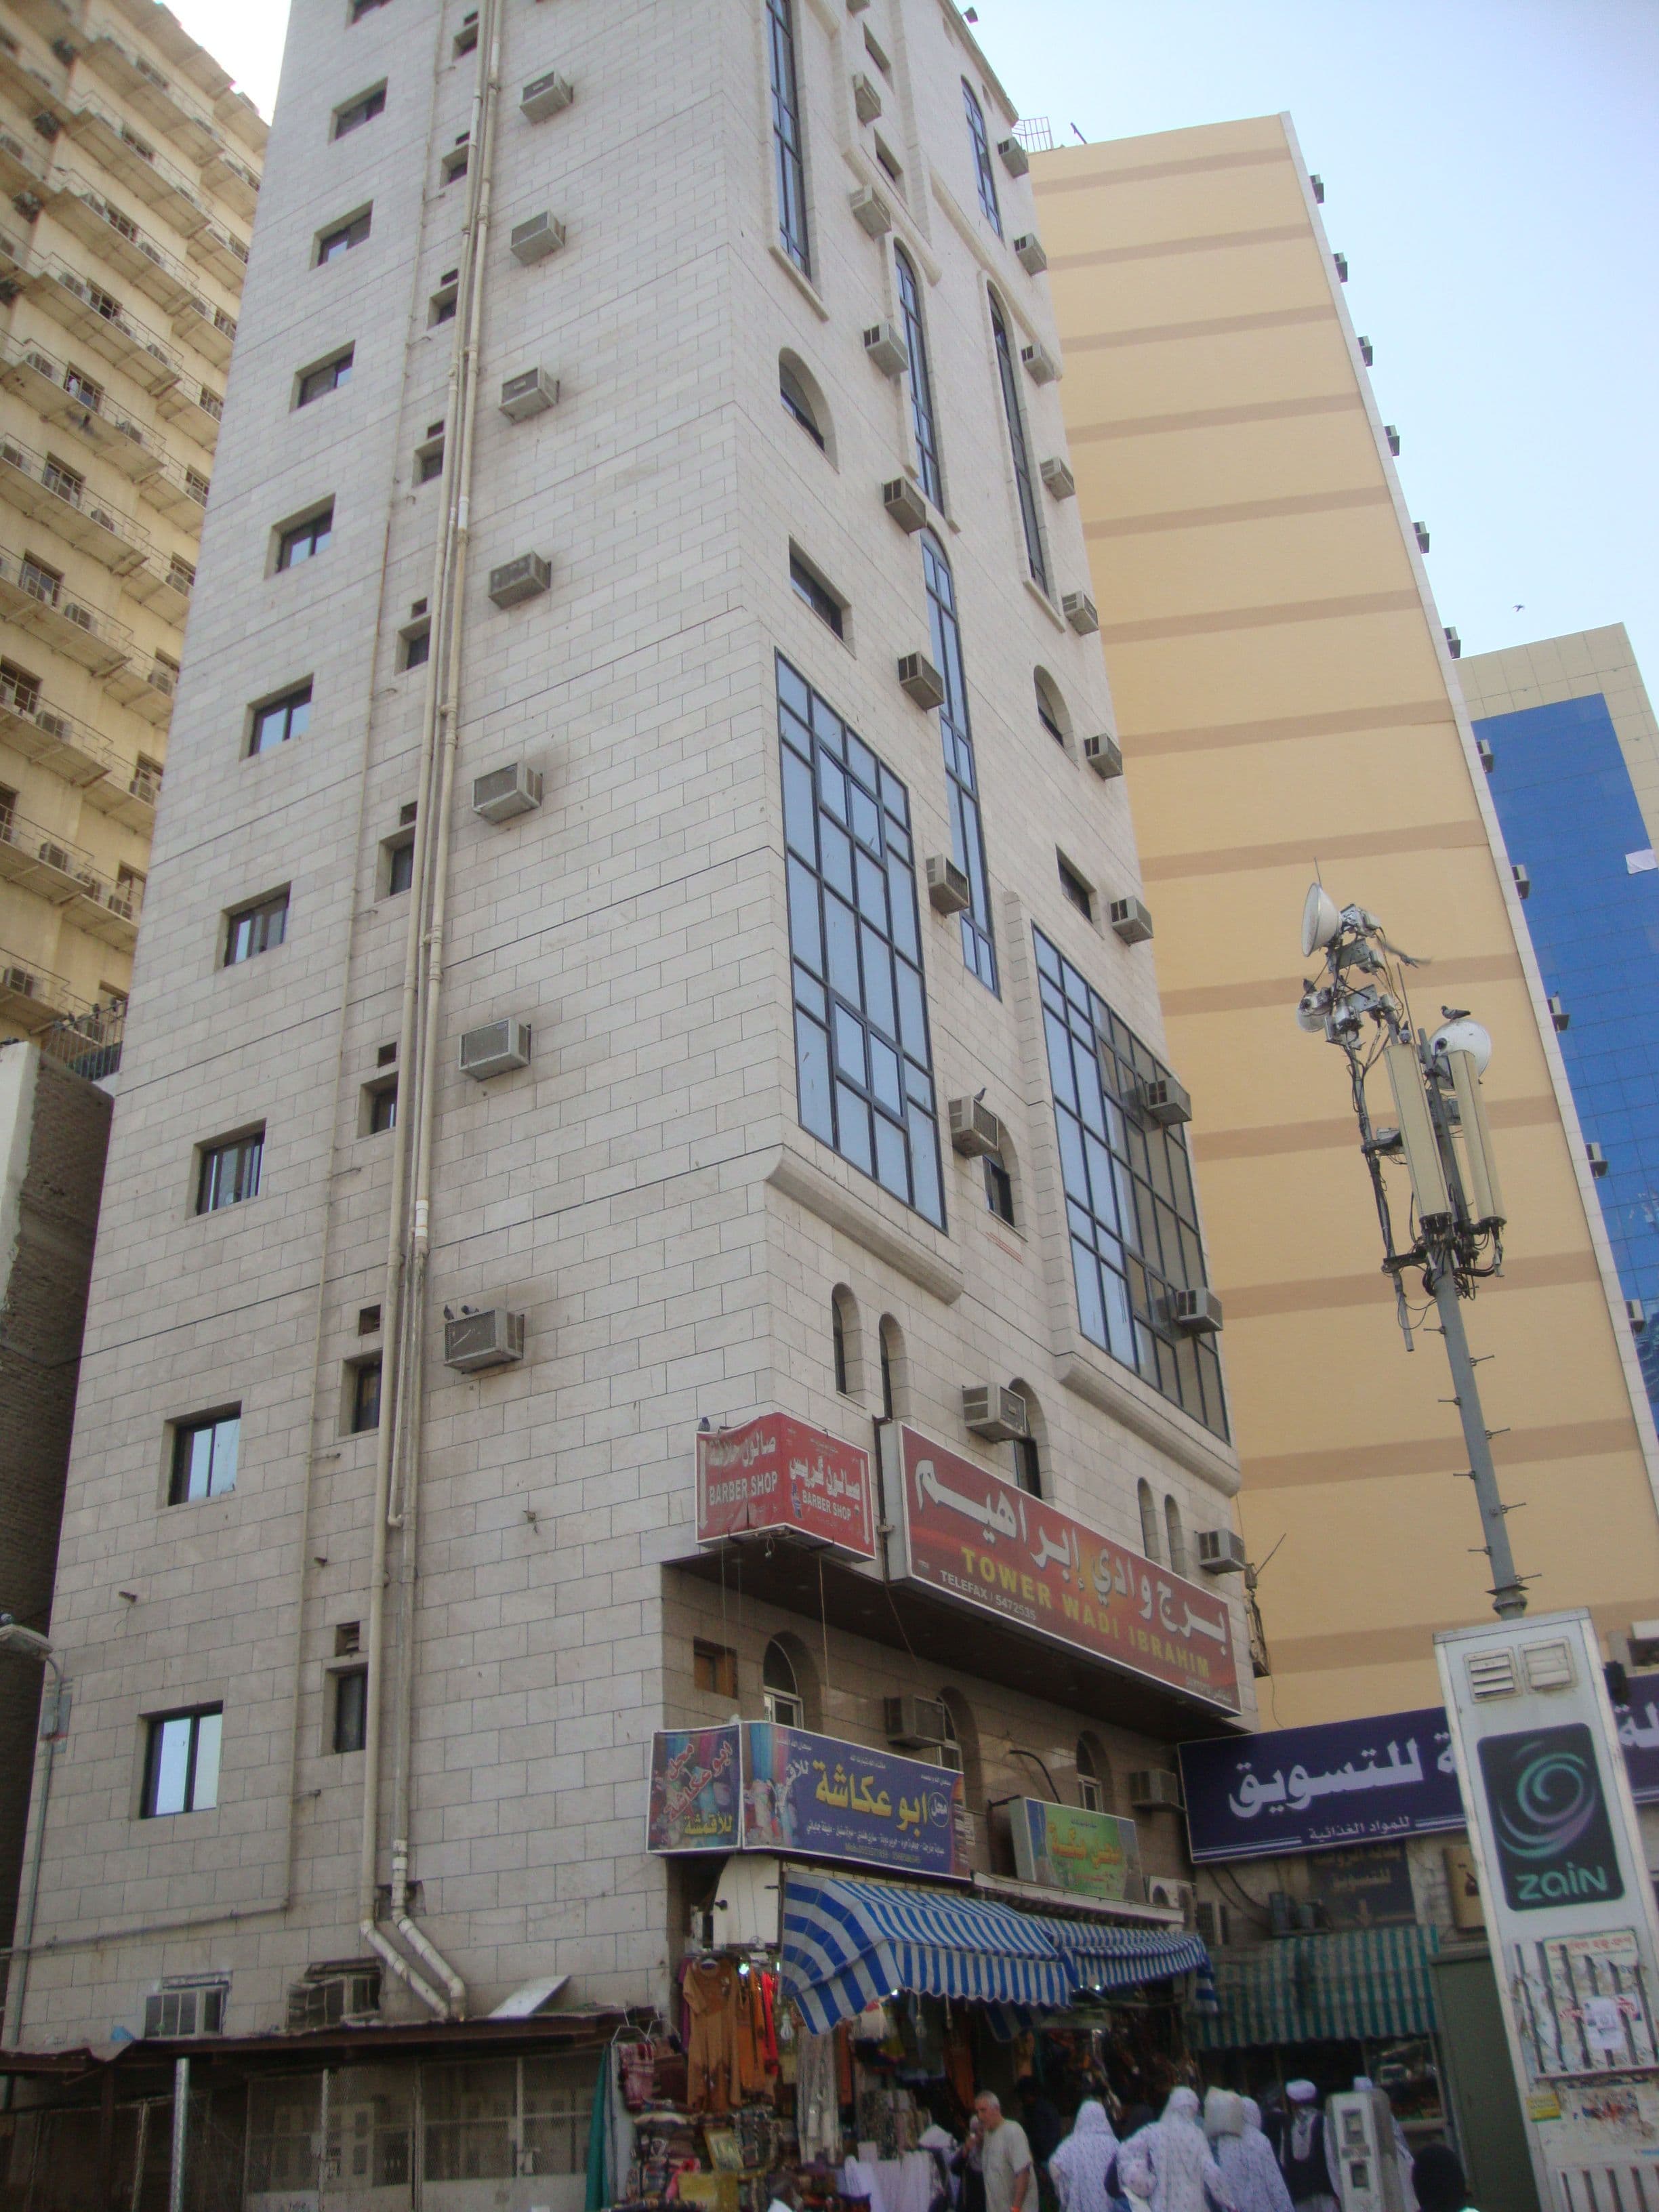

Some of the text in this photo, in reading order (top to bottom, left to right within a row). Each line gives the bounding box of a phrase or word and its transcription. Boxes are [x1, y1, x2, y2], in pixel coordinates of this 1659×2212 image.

[709, 1471, 778, 1506] BARBER SHOP
[802, 1489, 832, 1514] BARBER
[833, 1502, 852, 1521] SHOP
[939, 1569, 987, 1601] TELEFAX
[1092, 1548, 1153, 1621] وادي
[961, 1545, 1210, 1679] TOWER WADI IBRAHIM
[1156, 1579, 1227, 1656] برج
[813, 1759, 893, 1818] عكاشة
[1228, 1736, 1424, 1818] للتسويق
[895, 1790, 928, 1838] ابو
[1309, 1816, 1411, 1843] للمواد الغذائية
